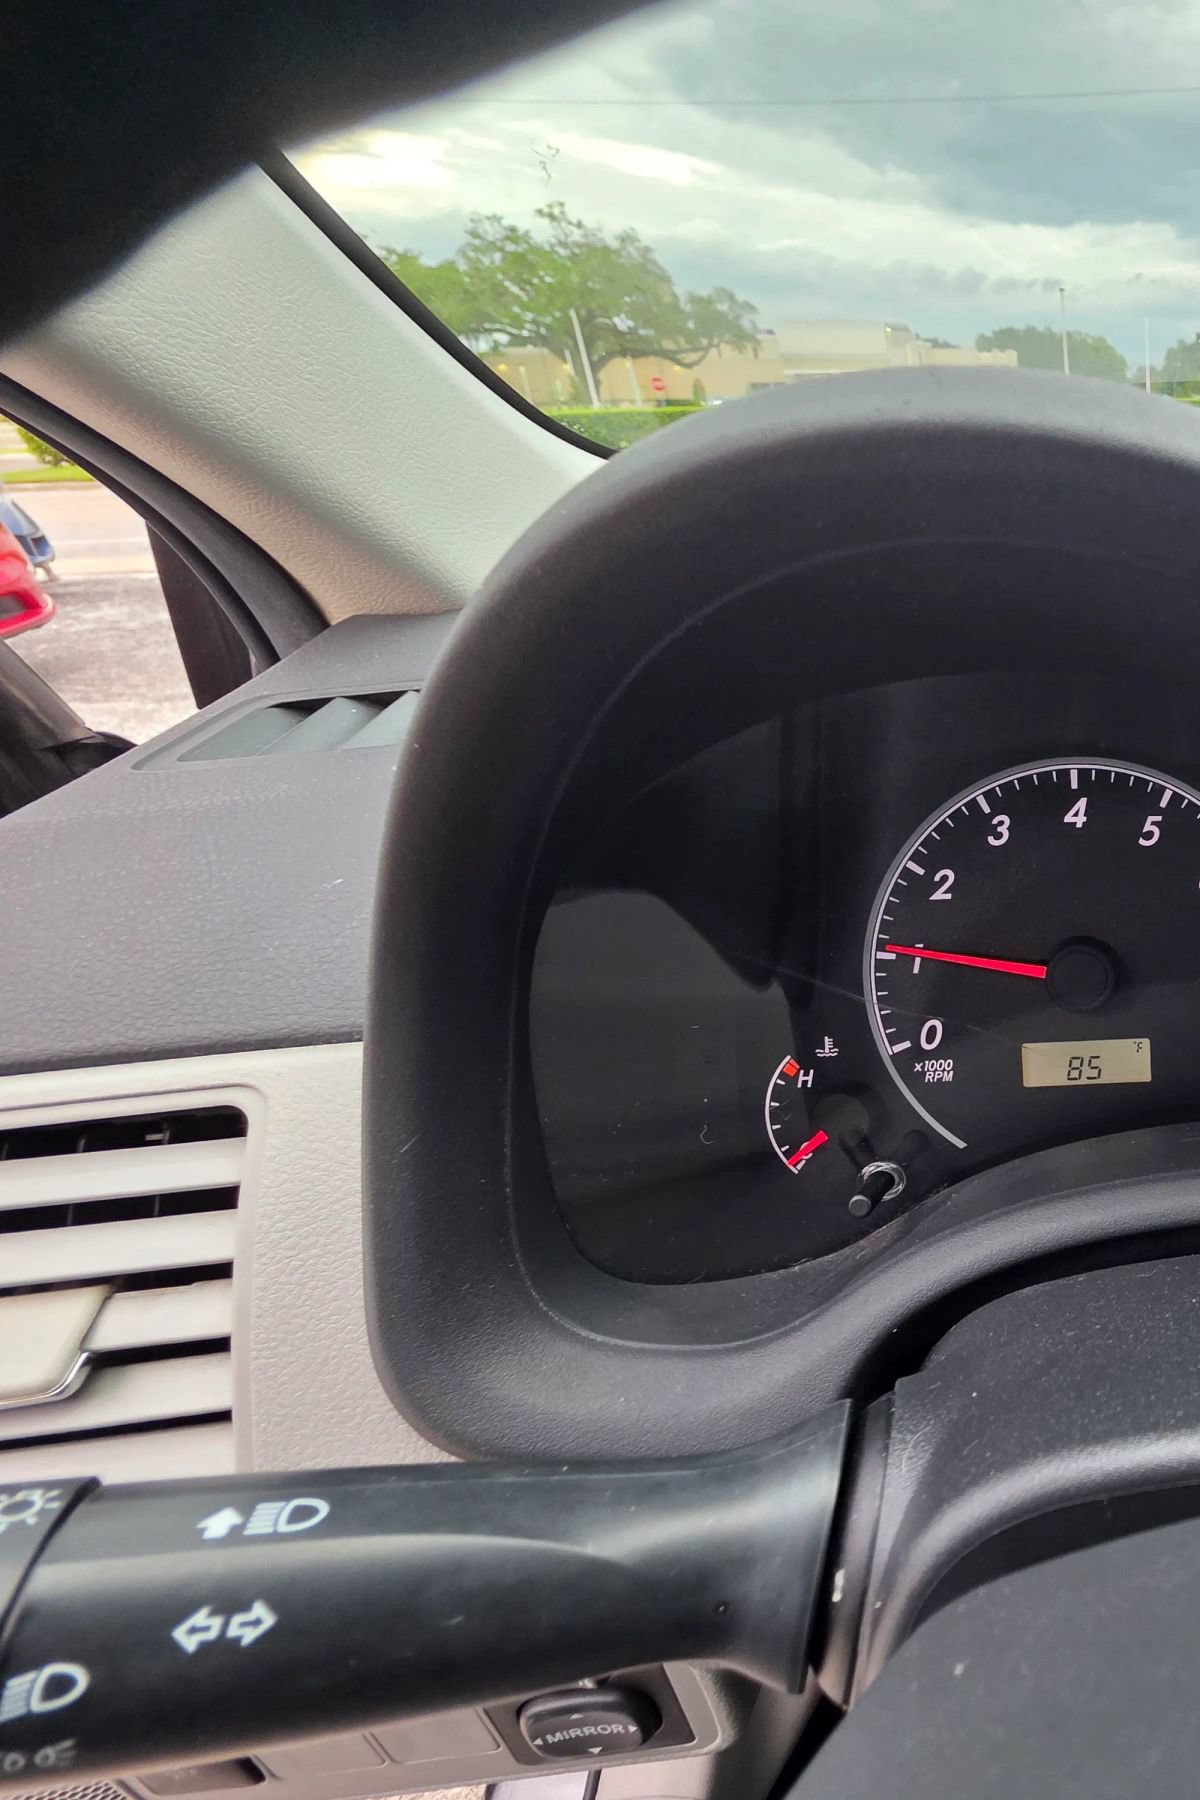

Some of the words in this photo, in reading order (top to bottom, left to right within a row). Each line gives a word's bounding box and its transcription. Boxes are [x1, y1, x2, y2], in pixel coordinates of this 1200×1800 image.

[1063, 797, 1088, 829] 4
[987, 814, 1011, 847] 3
[1138, 815, 1163, 847] 5
[928, 868, 955, 901] 2
[912, 943, 925, 974] 1
[920, 1018, 943, 1051] 0
[796, 1069, 814, 1089] H
[924, 1070, 954, 1083] RPM
[1067, 1055, 1101, 1080] 85
[545, 1724, 625, 1744] MIRROR
